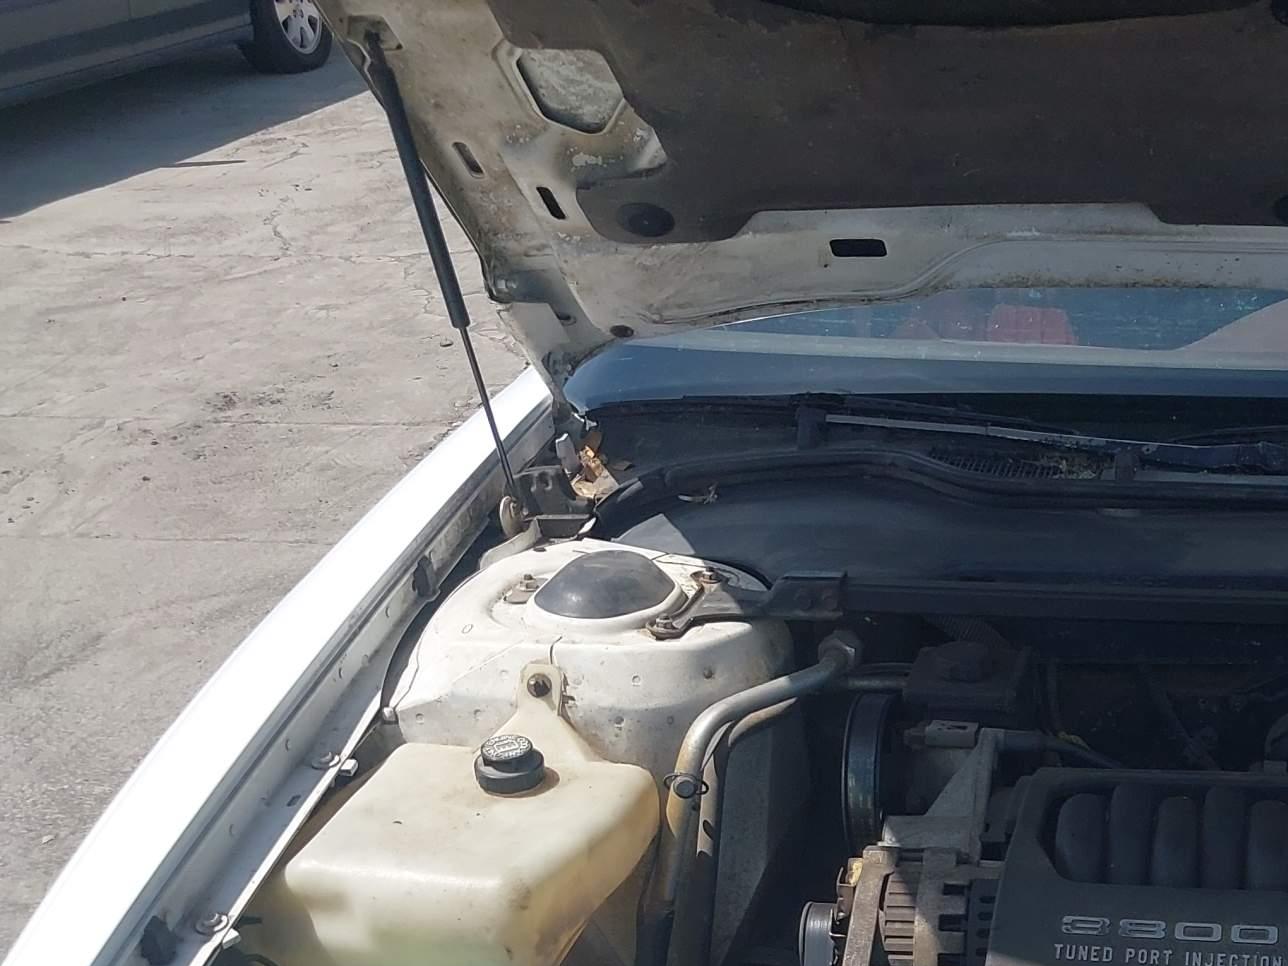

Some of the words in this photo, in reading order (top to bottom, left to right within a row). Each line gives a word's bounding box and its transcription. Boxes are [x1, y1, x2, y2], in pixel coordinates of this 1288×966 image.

[1061, 915, 1279, 945] 3800
[1054, 943, 1114, 964] TUNED
[1124, 947, 1173, 966] PORT
